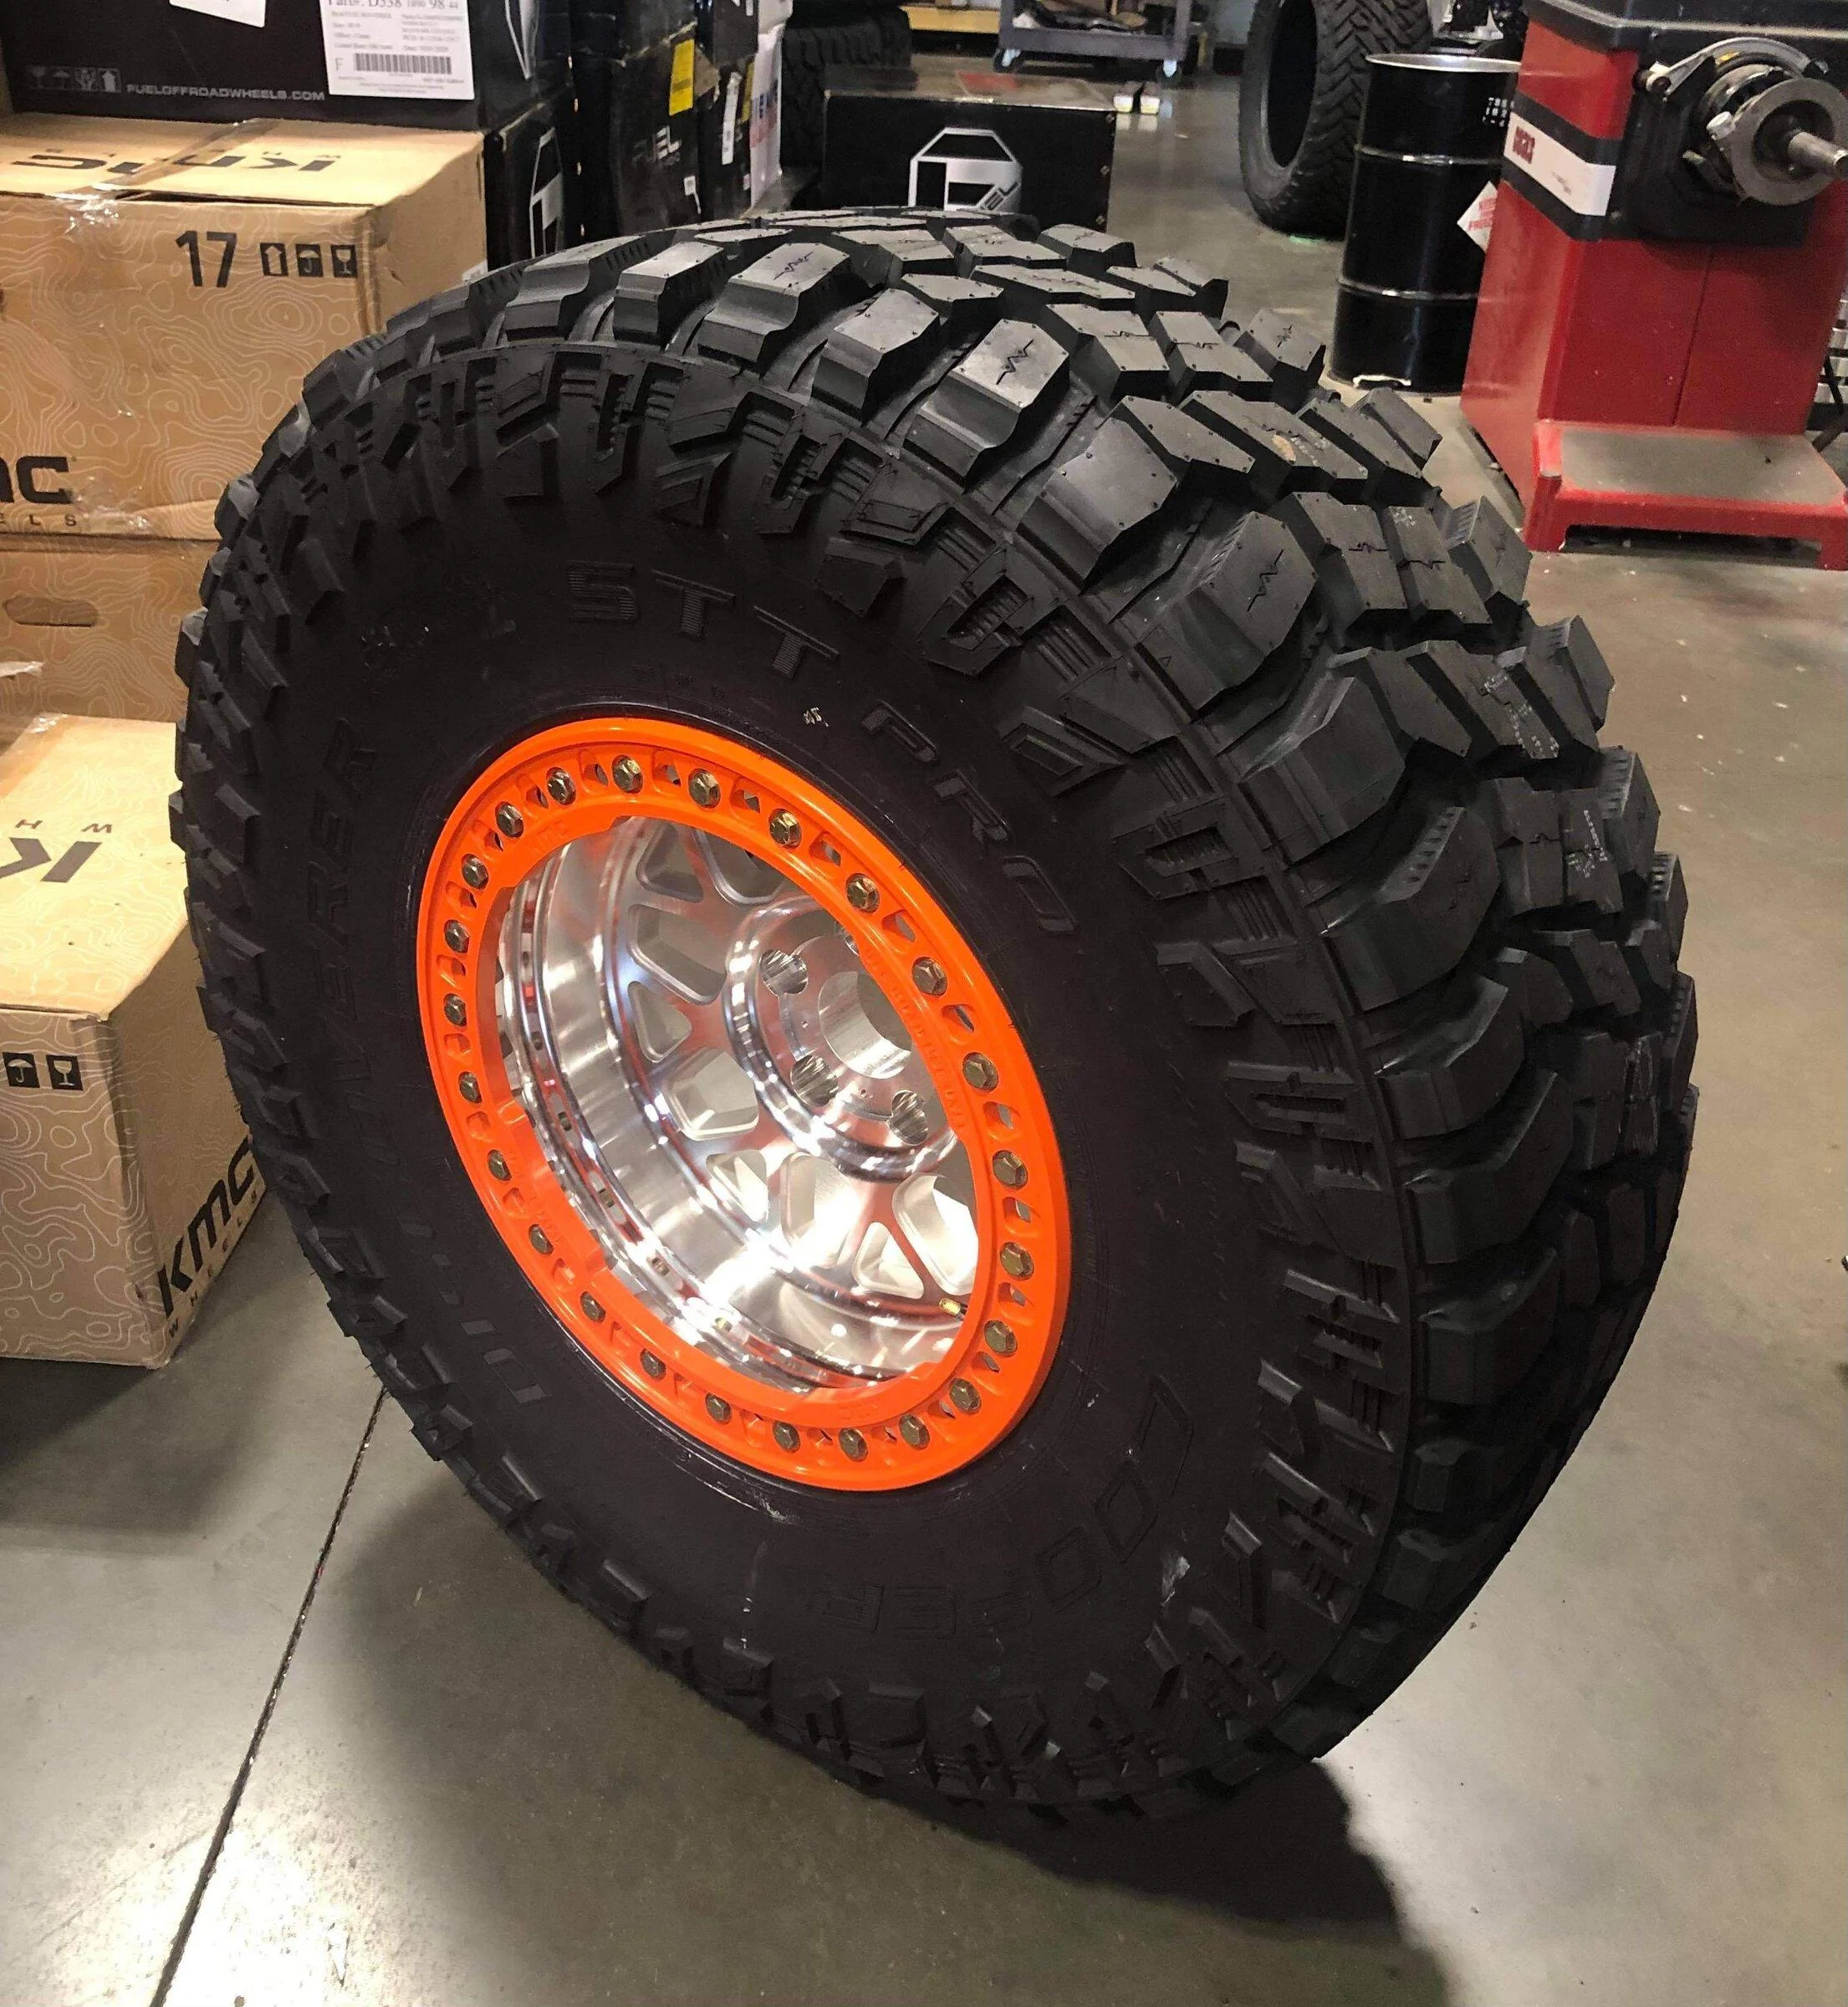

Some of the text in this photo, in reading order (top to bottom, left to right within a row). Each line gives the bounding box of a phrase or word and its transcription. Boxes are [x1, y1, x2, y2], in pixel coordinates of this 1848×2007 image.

[127, 84, 326, 101] FUELOFFROADWHEELS.COM
[176, 230, 237, 289] 17
[565, 559, 1080, 934] STT PRO
